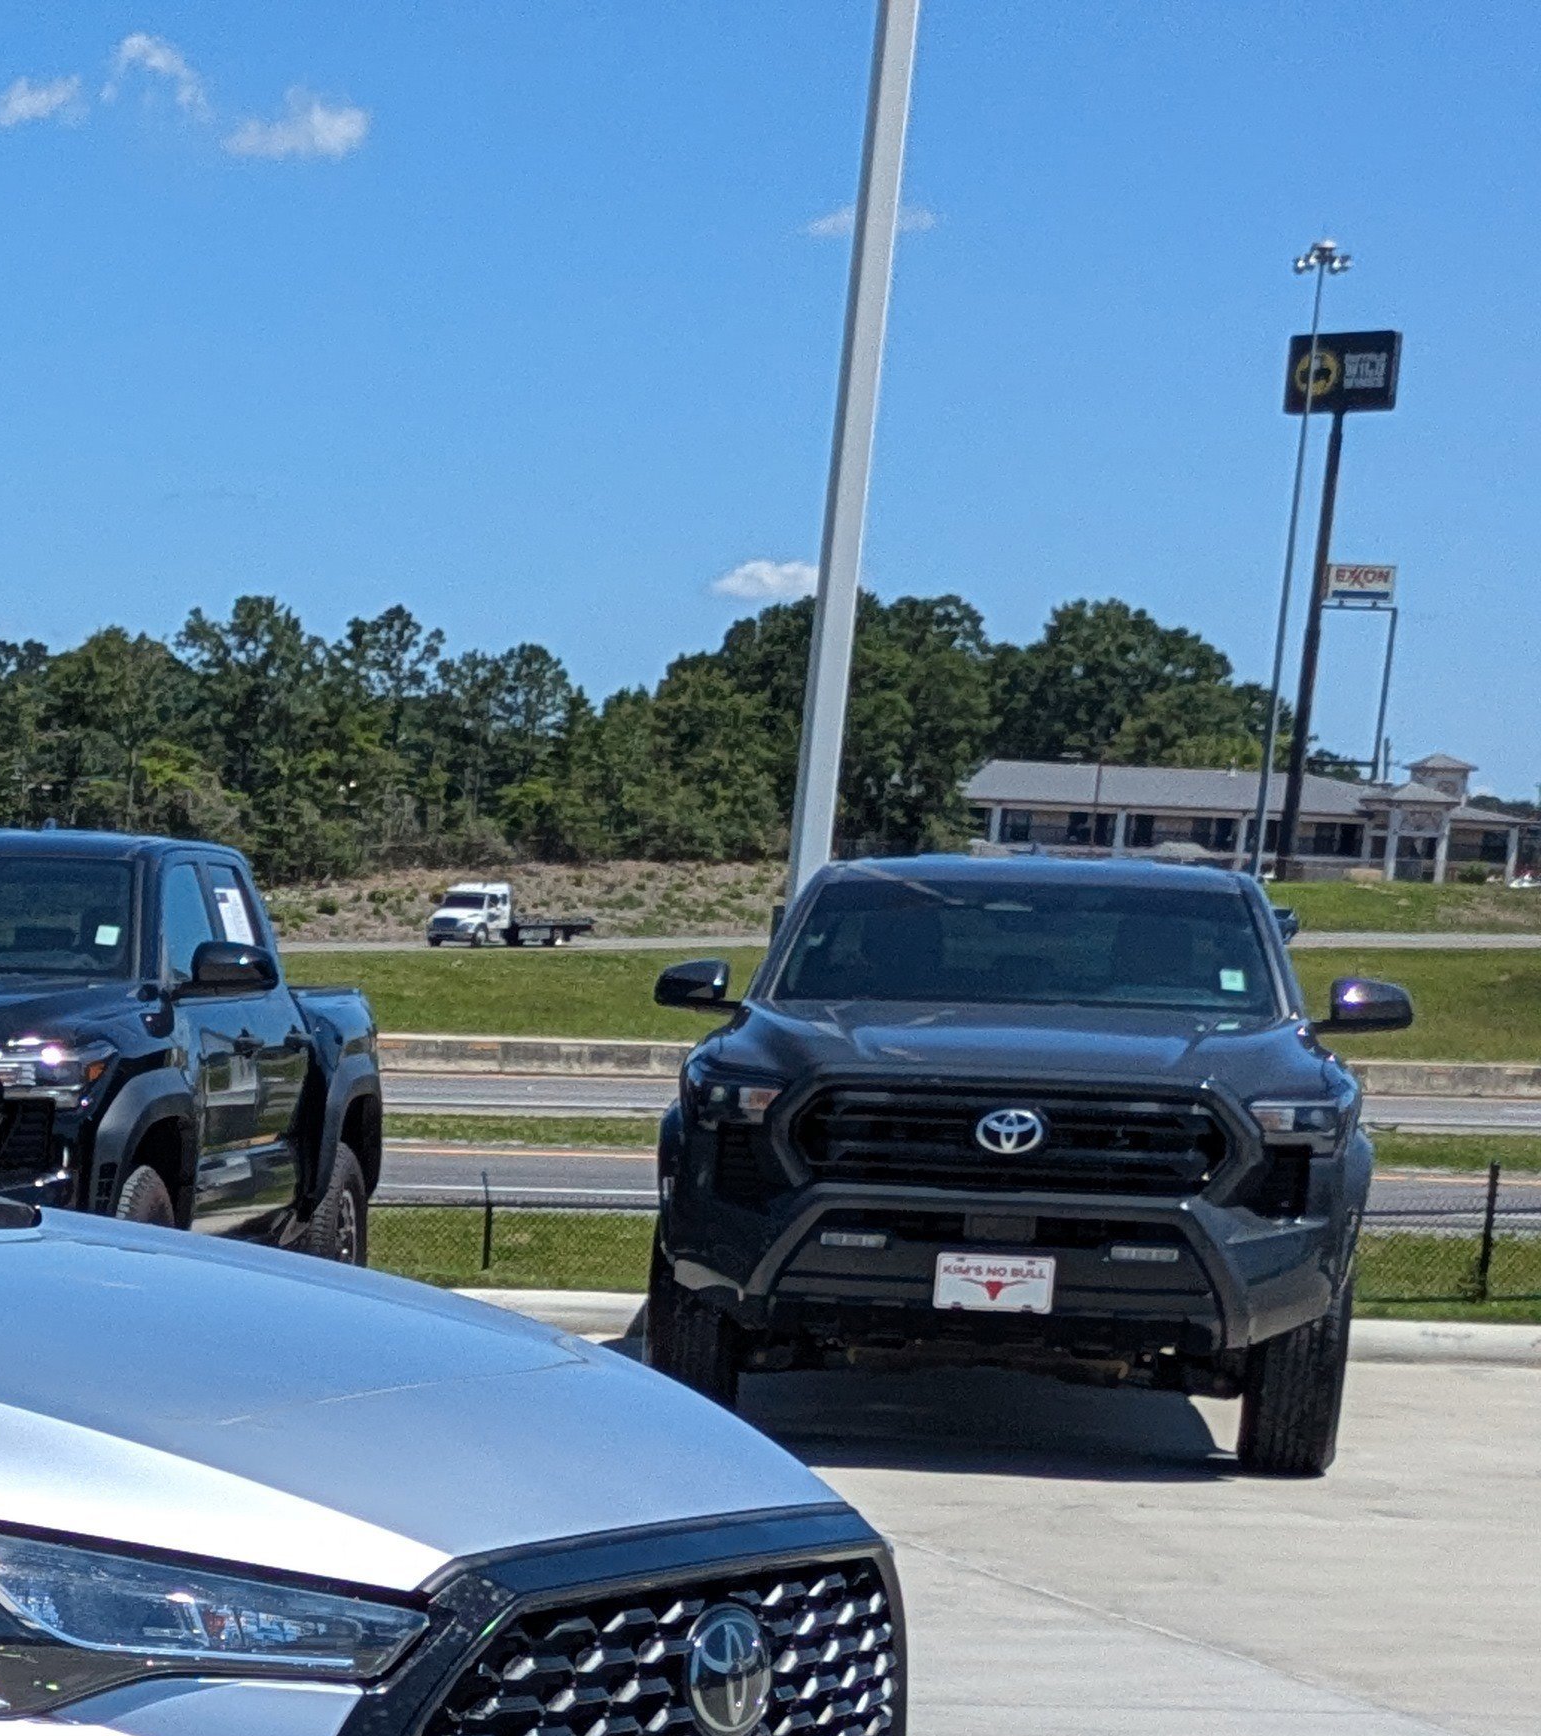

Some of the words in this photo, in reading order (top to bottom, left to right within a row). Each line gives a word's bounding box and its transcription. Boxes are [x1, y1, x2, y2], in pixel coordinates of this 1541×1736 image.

[1335, 567, 1391, 589] EXXON
[942, 1264, 983, 1277] KIM'S
[986, 1266, 1008, 1278] NO
[1011, 1267, 1047, 1280] BULL
